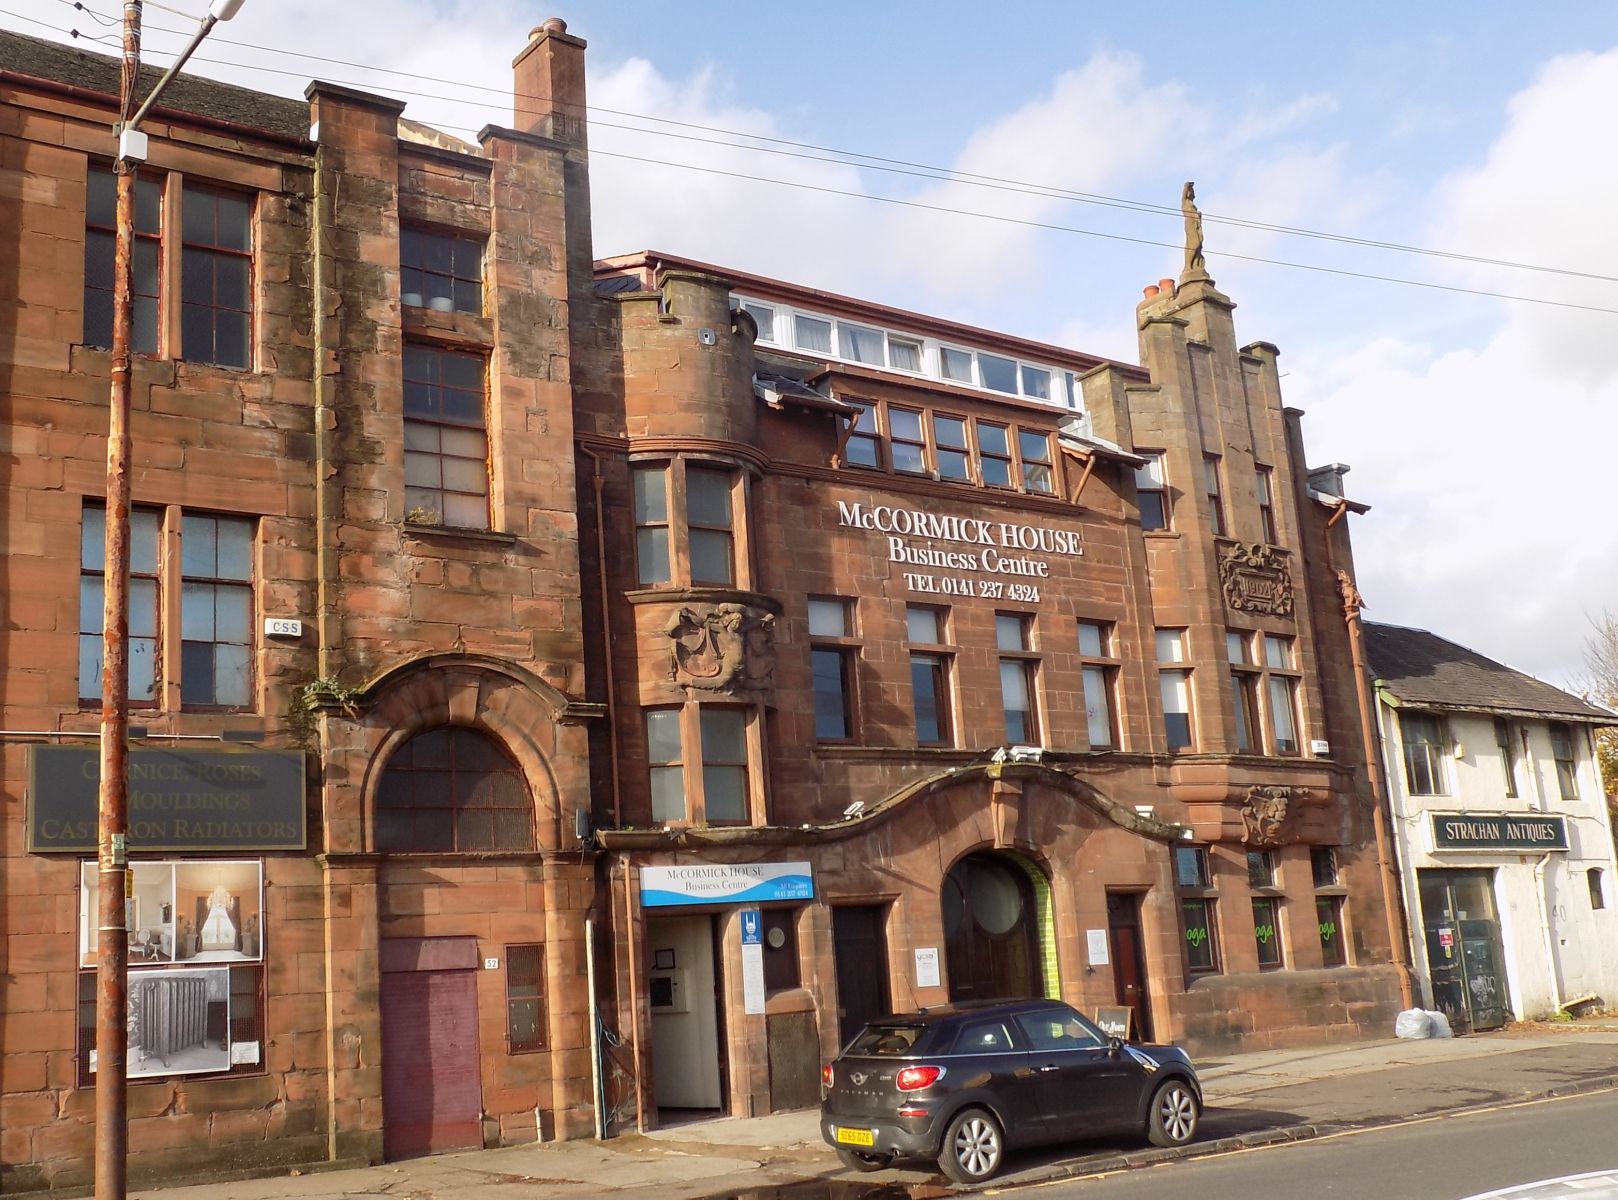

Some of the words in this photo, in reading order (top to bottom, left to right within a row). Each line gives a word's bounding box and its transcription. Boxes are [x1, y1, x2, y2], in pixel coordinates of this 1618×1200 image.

[836, 500, 997, 546] McCORMICK
[998, 522, 1083, 556] HOUSE
[887, 536, 977, 571] Business
[981, 548, 1049, 578] Centre
[903, 572, 941, 592] TEL
[941, 577, 976, 597] 0141
[979, 580, 1003, 599] 237
[1007, 582, 1041, 603] 4324
[174, 819, 297, 840] RADIATORS
[1445, 822, 1500, 841] STRACHAN
[1506, 823, 1555, 842] ANTIQUES
[667, 867, 728, 880] McCORMICK
[729, 866, 765, 877] HOUSE
[685, 881, 720, 892] Business
[721, 880, 748, 890] Centre
[487, 959, 497, 968] 52
